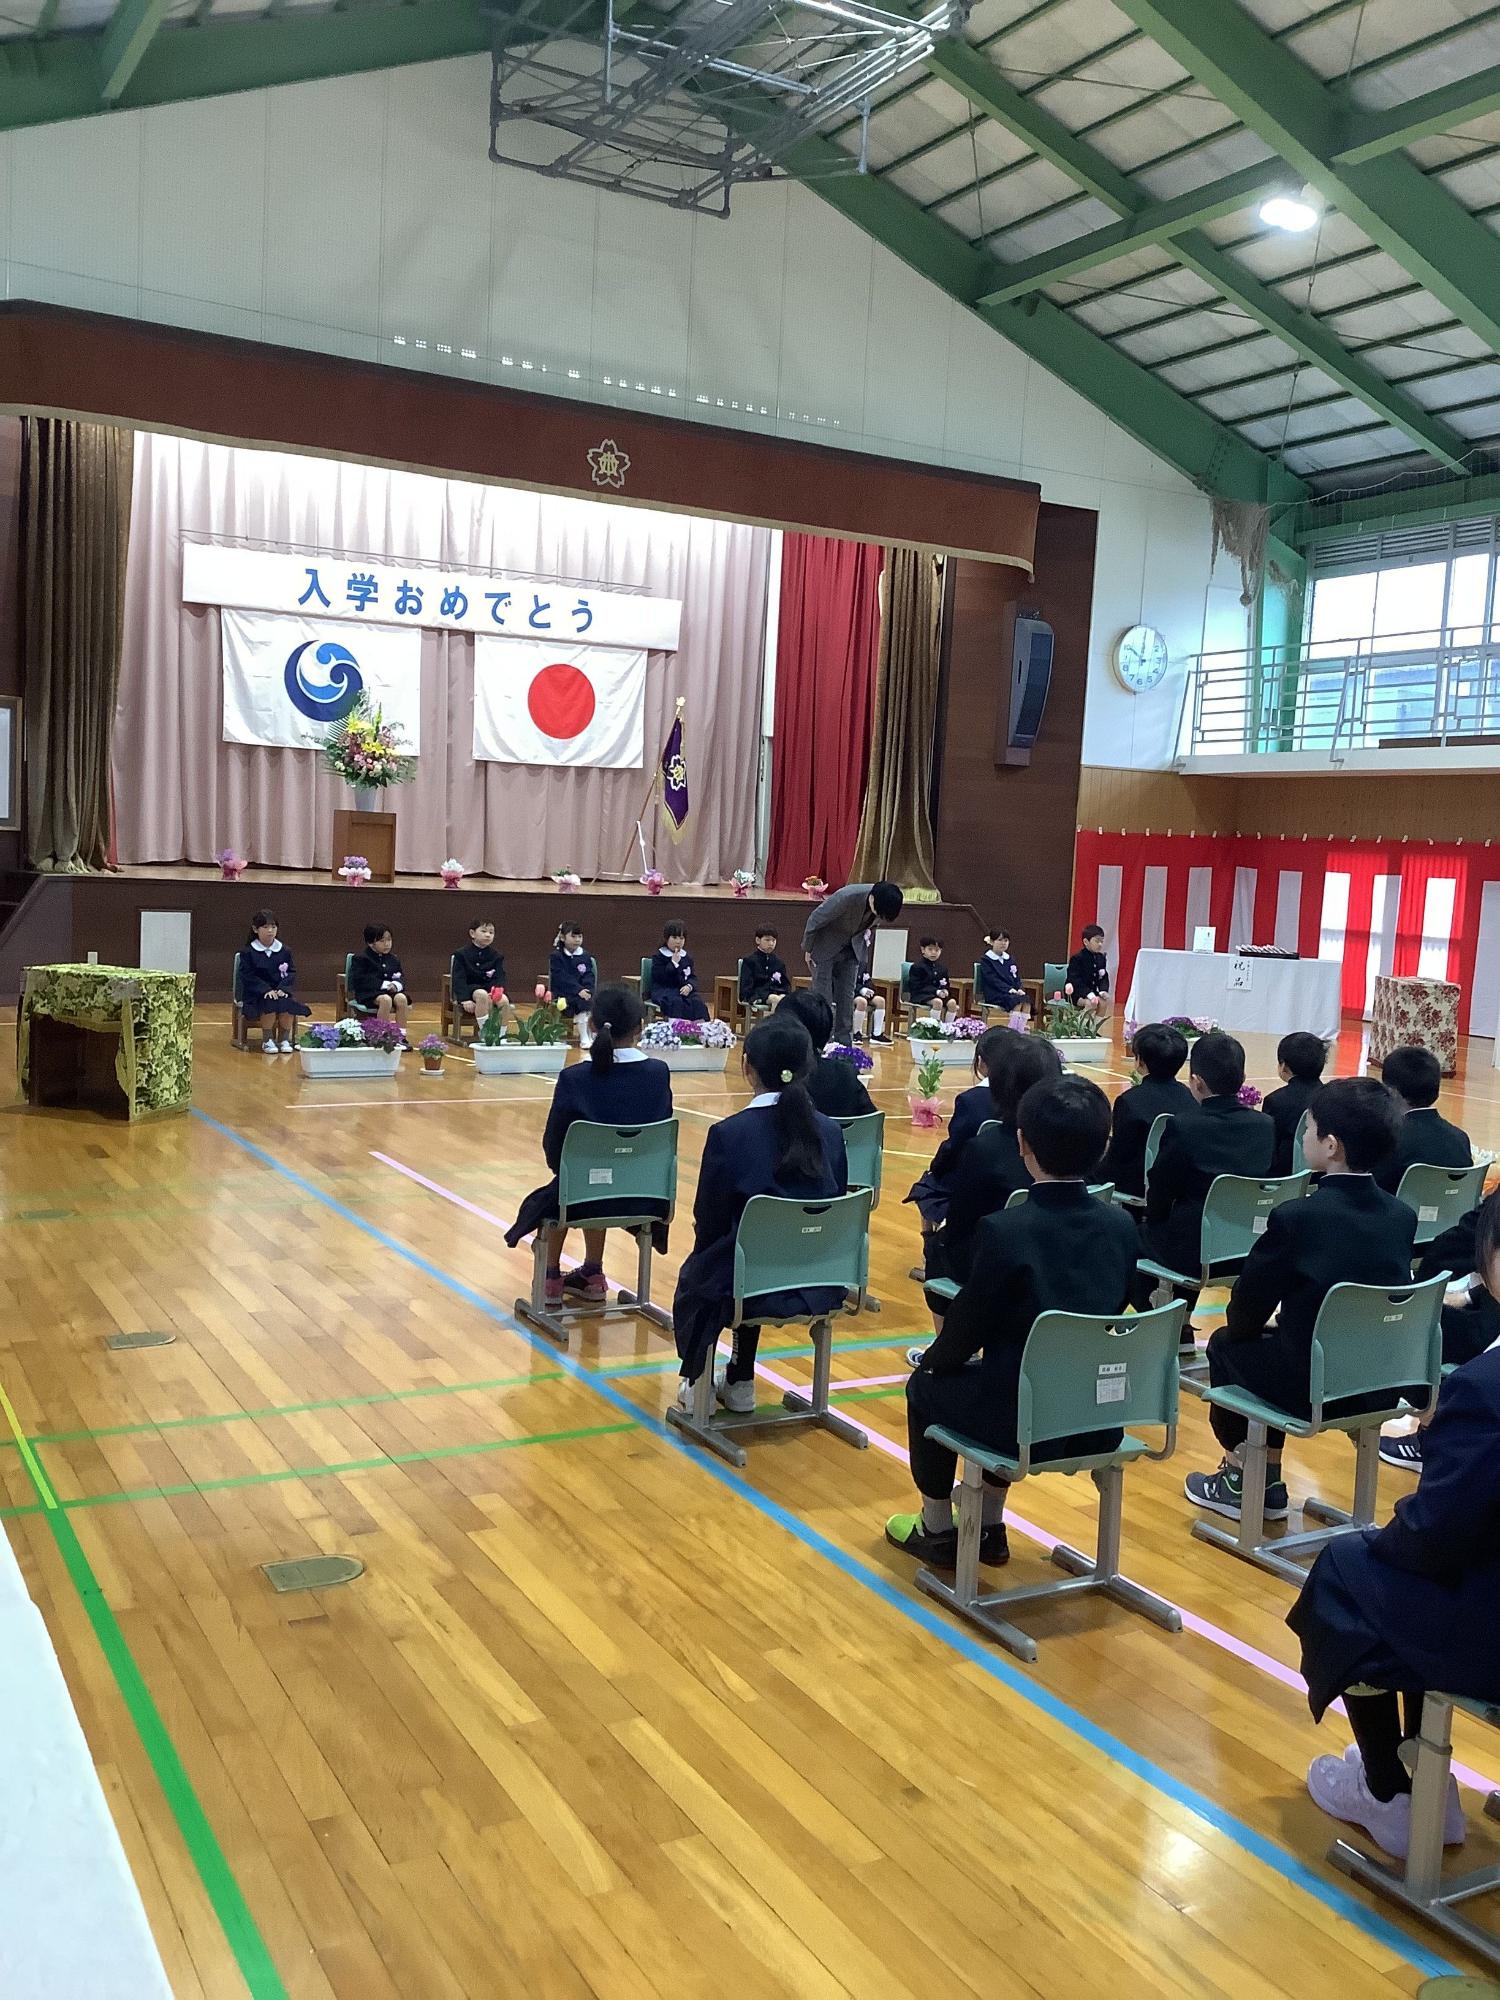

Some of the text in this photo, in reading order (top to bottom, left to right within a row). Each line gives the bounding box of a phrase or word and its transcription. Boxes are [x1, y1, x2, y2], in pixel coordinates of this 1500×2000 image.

[298, 568, 593, 633] 入学おめでとう
